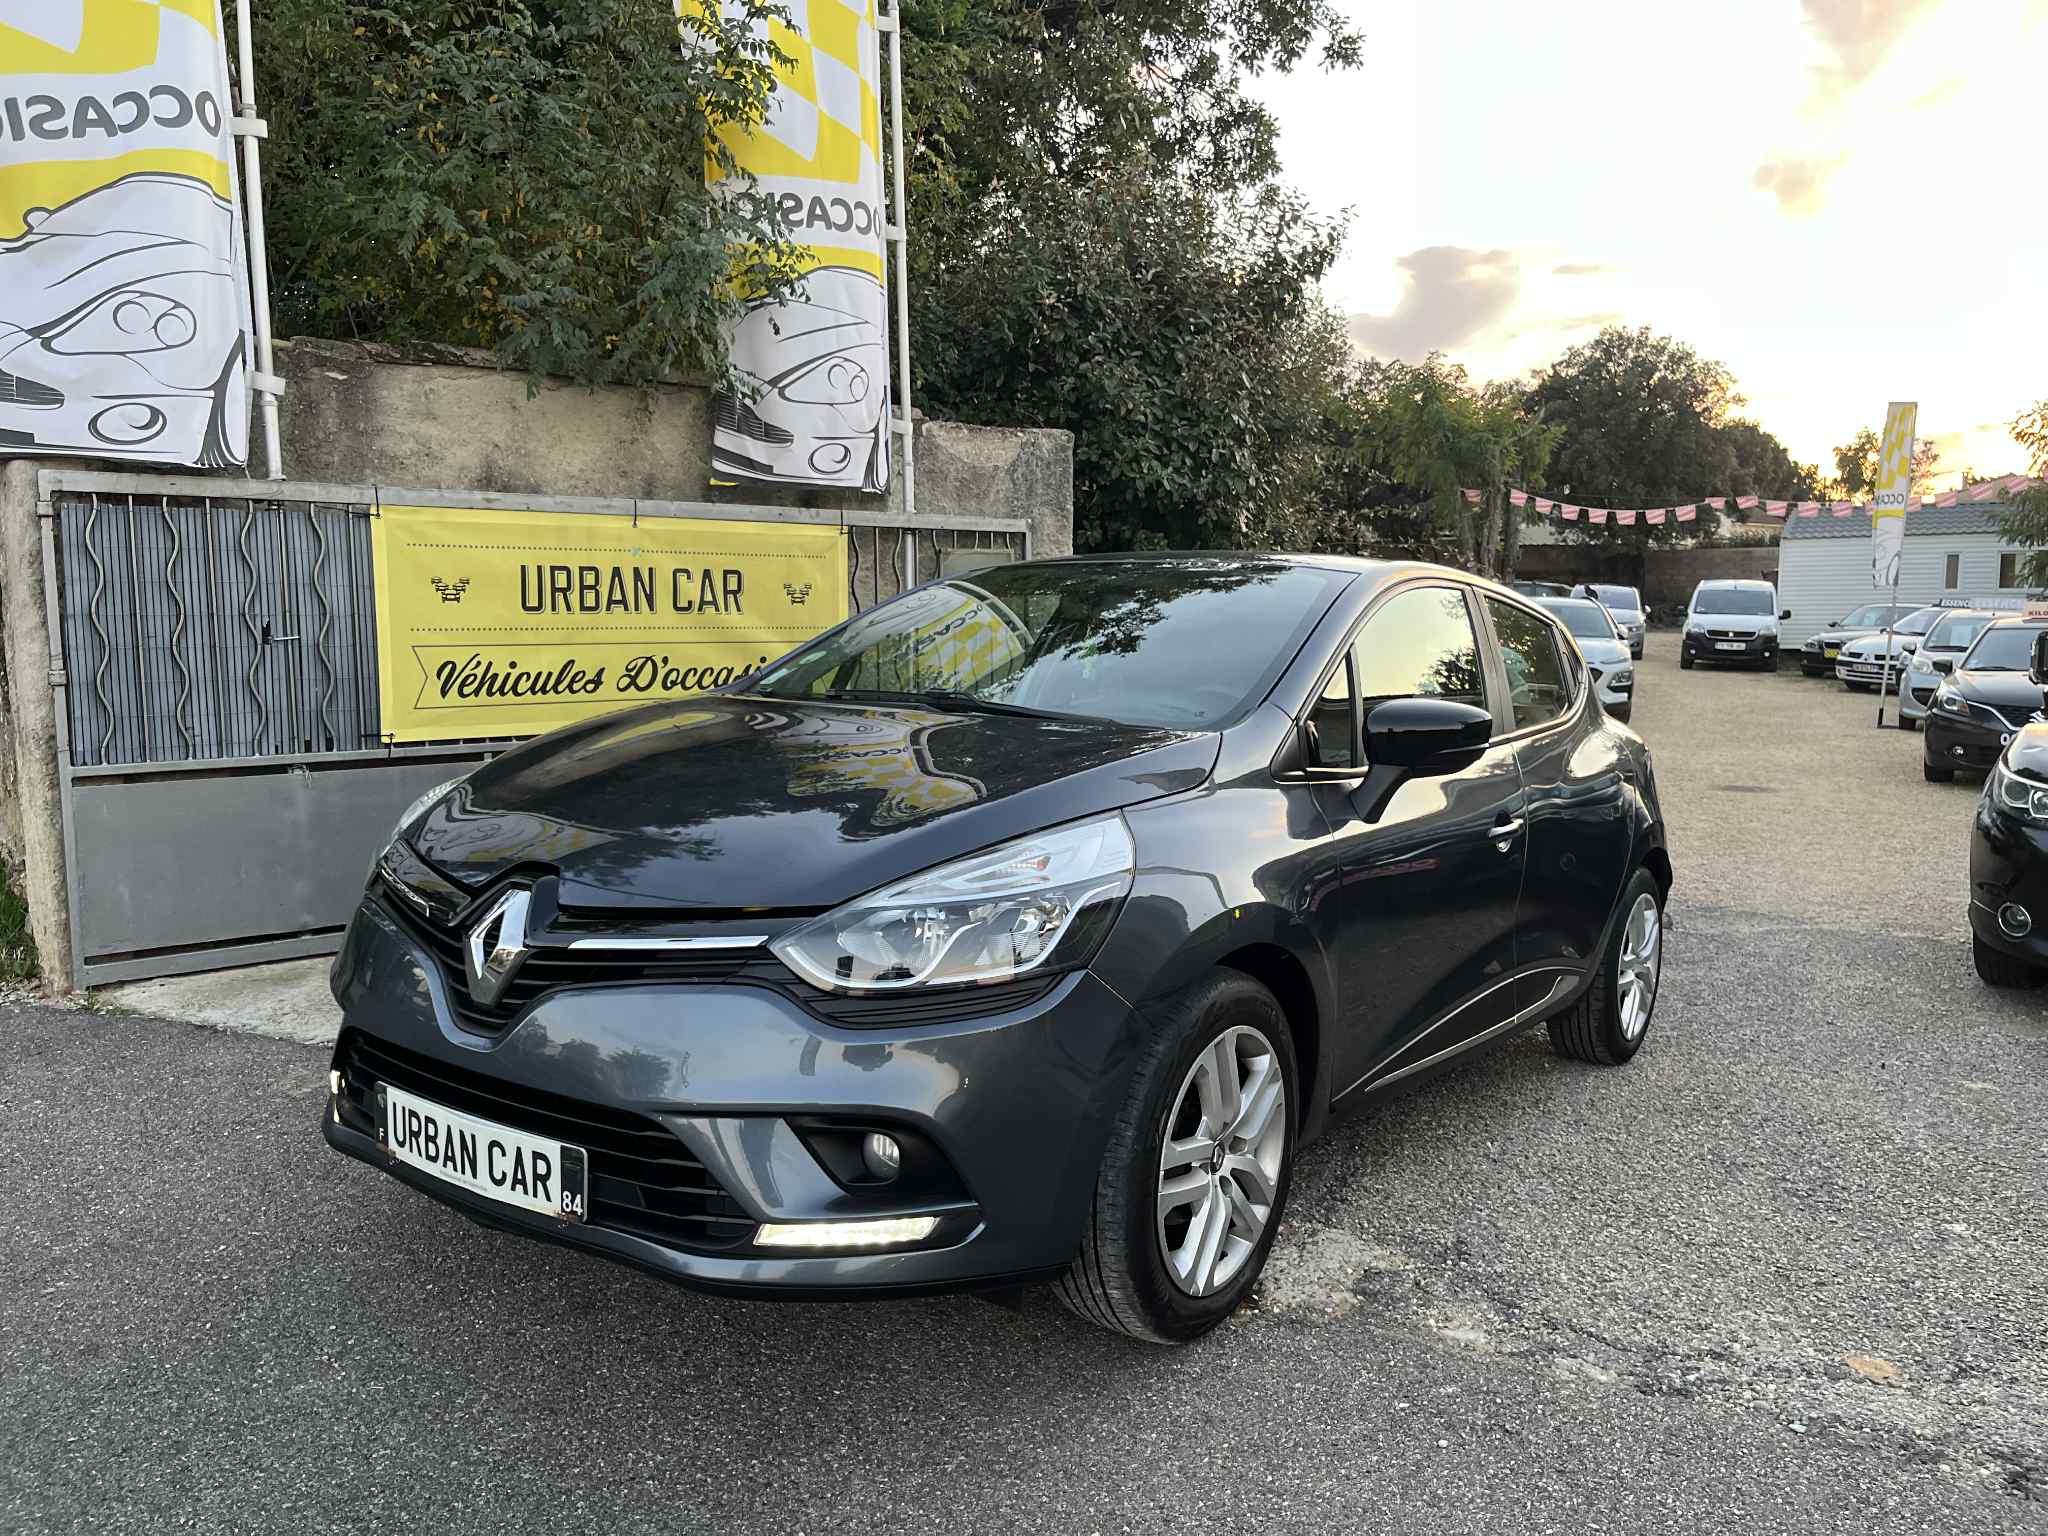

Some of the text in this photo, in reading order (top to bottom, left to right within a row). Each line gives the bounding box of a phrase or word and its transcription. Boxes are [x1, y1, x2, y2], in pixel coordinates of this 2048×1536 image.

[520, 564, 744, 616] URBAN CAR
[436, 652, 606, 699] Véhicules
[378, 1127, 385, 1141] F
[392, 1102, 478, 1180] URBAN
[488, 1140, 553, 1203] CAR
[562, 1191, 583, 1216] 84
